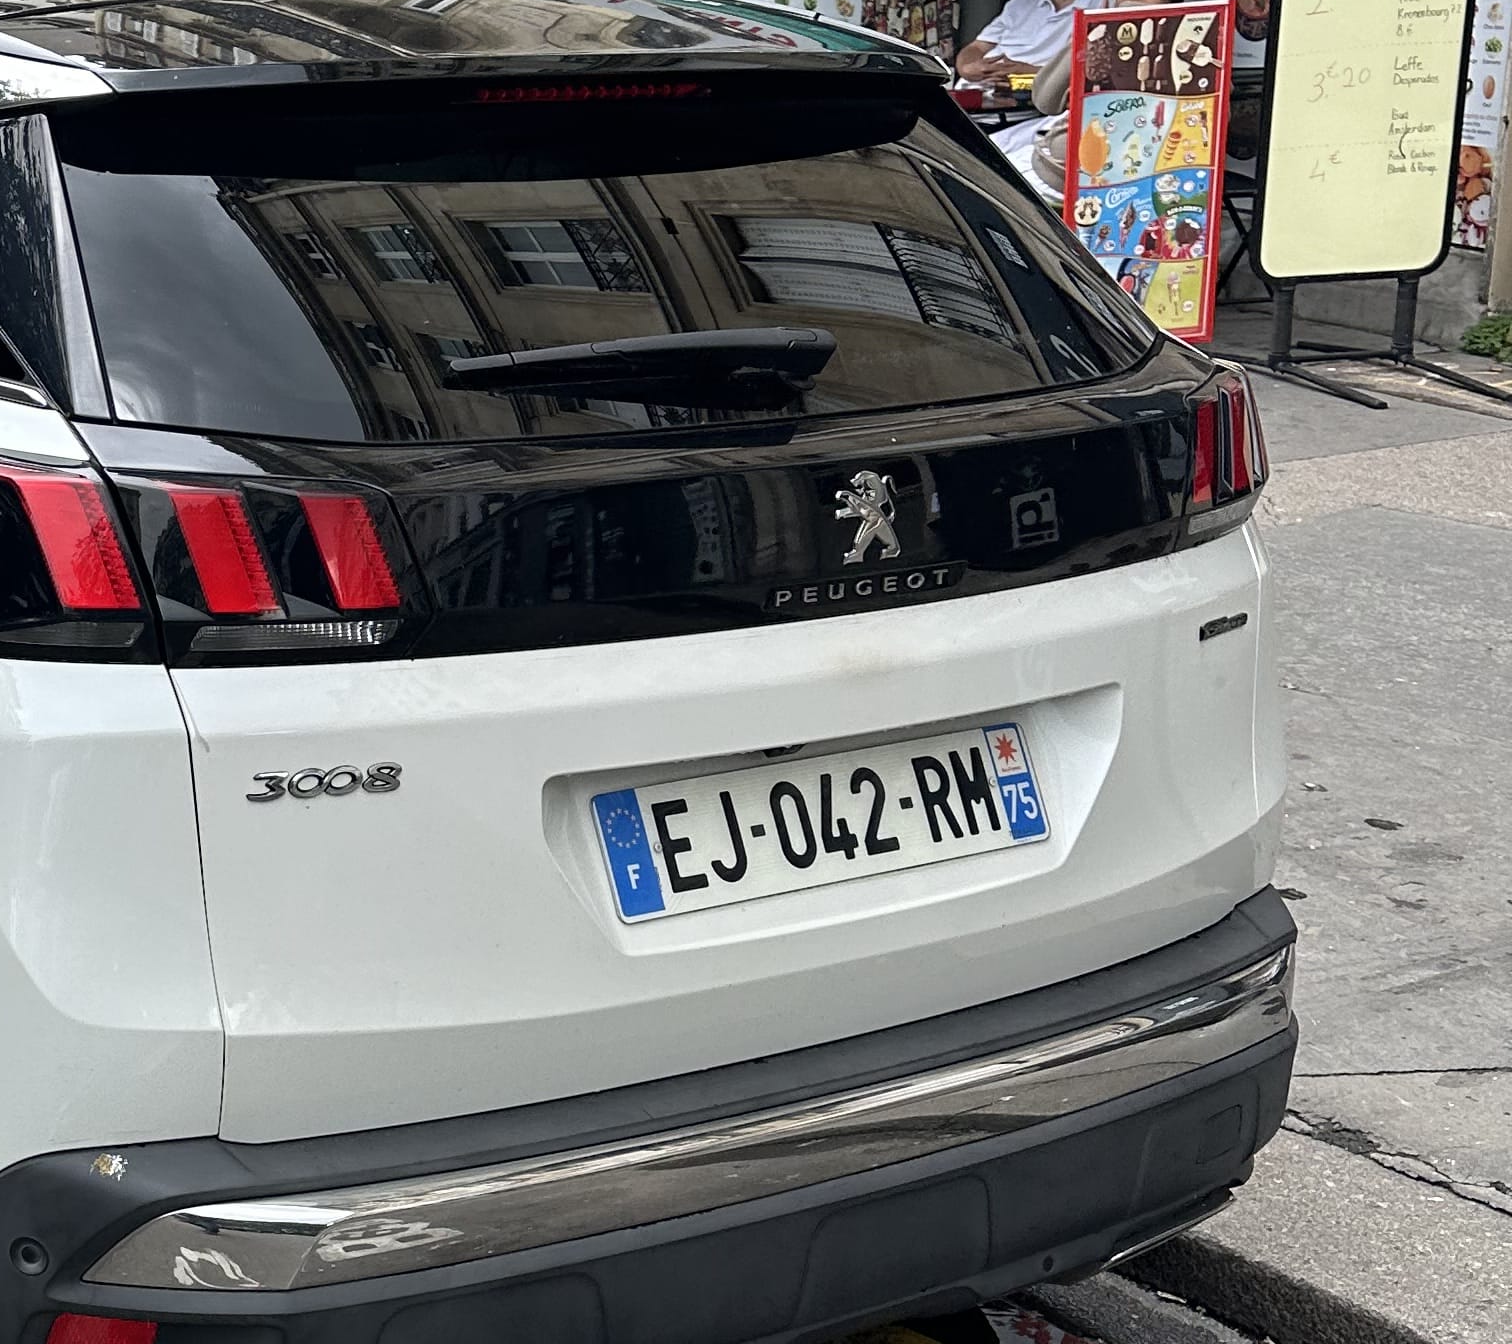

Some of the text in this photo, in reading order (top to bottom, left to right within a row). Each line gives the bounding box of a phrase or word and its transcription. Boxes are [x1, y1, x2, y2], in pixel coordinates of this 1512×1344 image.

[1394, 55, 1423, 72] Leffe
[774, 565, 951, 609] PEUGEOT
[246, 761, 403, 804] 3008
[1002, 781, 1039, 824] 75
[652, 746, 1001, 894] EJ-042-RM
[626, 862, 642, 893] F
